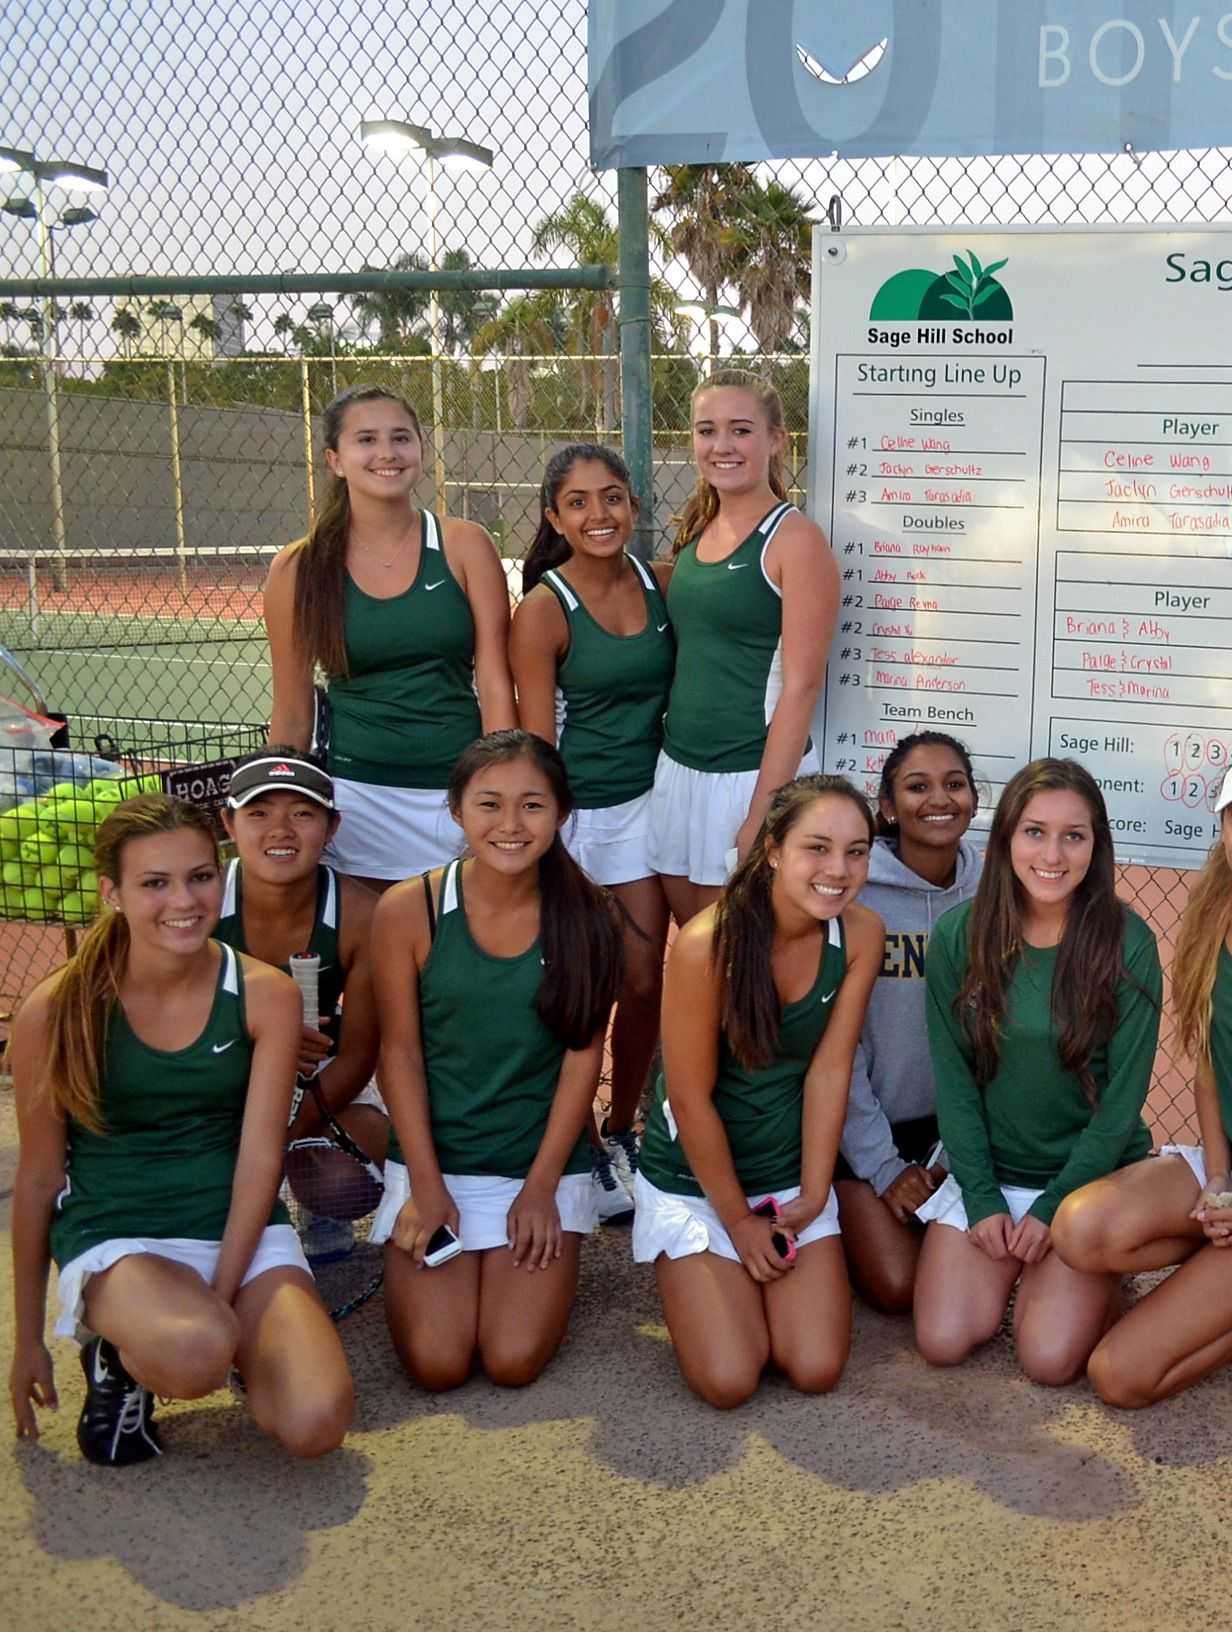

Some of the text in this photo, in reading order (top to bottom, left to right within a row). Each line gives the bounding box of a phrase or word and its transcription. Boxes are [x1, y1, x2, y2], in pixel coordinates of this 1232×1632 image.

[868, 328, 1013, 347] Sage Hill School
[857, 363, 1022, 388] Starting Line Up
[910, 409, 964, 425] Singles
[1162, 419, 1220, 439] Player
[847, 437, 867, 449] #1
[1104, 450, 1153, 468] Celine
[1169, 453, 1211, 470] Wang
[847, 463, 868, 476] #2
[846, 490, 867, 503] #3
[1104, 479, 1157, 499] Jaclyn
[903, 515, 966, 530] Doubles
[1112, 511, 1151, 528] Amira
[843, 541, 864, 555] #1
[842, 568, 864, 581] #1
[842, 594, 864, 608] #2
[1155, 591, 1210, 611] Player
[840, 621, 863, 635] #2
[1067, 616, 1116, 635] Briana
[840, 647, 862, 660] #3
[1082, 651, 1117, 671] Paige
[839, 673, 861, 686] #3
[881, 703, 974, 721] Team Bench
[837, 732, 857, 746] #1
[1060, 734, 1099, 753] Sage
[1104, 737, 1134, 753] Hill:
[1173, 742, 1179, 756] 1
[1191, 744, 1200, 758] 2
[1210, 744, 1221, 759] 3
[835, 759, 857, 772] #2
[1095, 778, 1144, 793] onent:
[1170, 781, 1177, 795] 1
[1189, 782, 1198, 797] 2
[1108, 818, 1147, 833] core:
[1165, 820, 1203, 840] Sage
